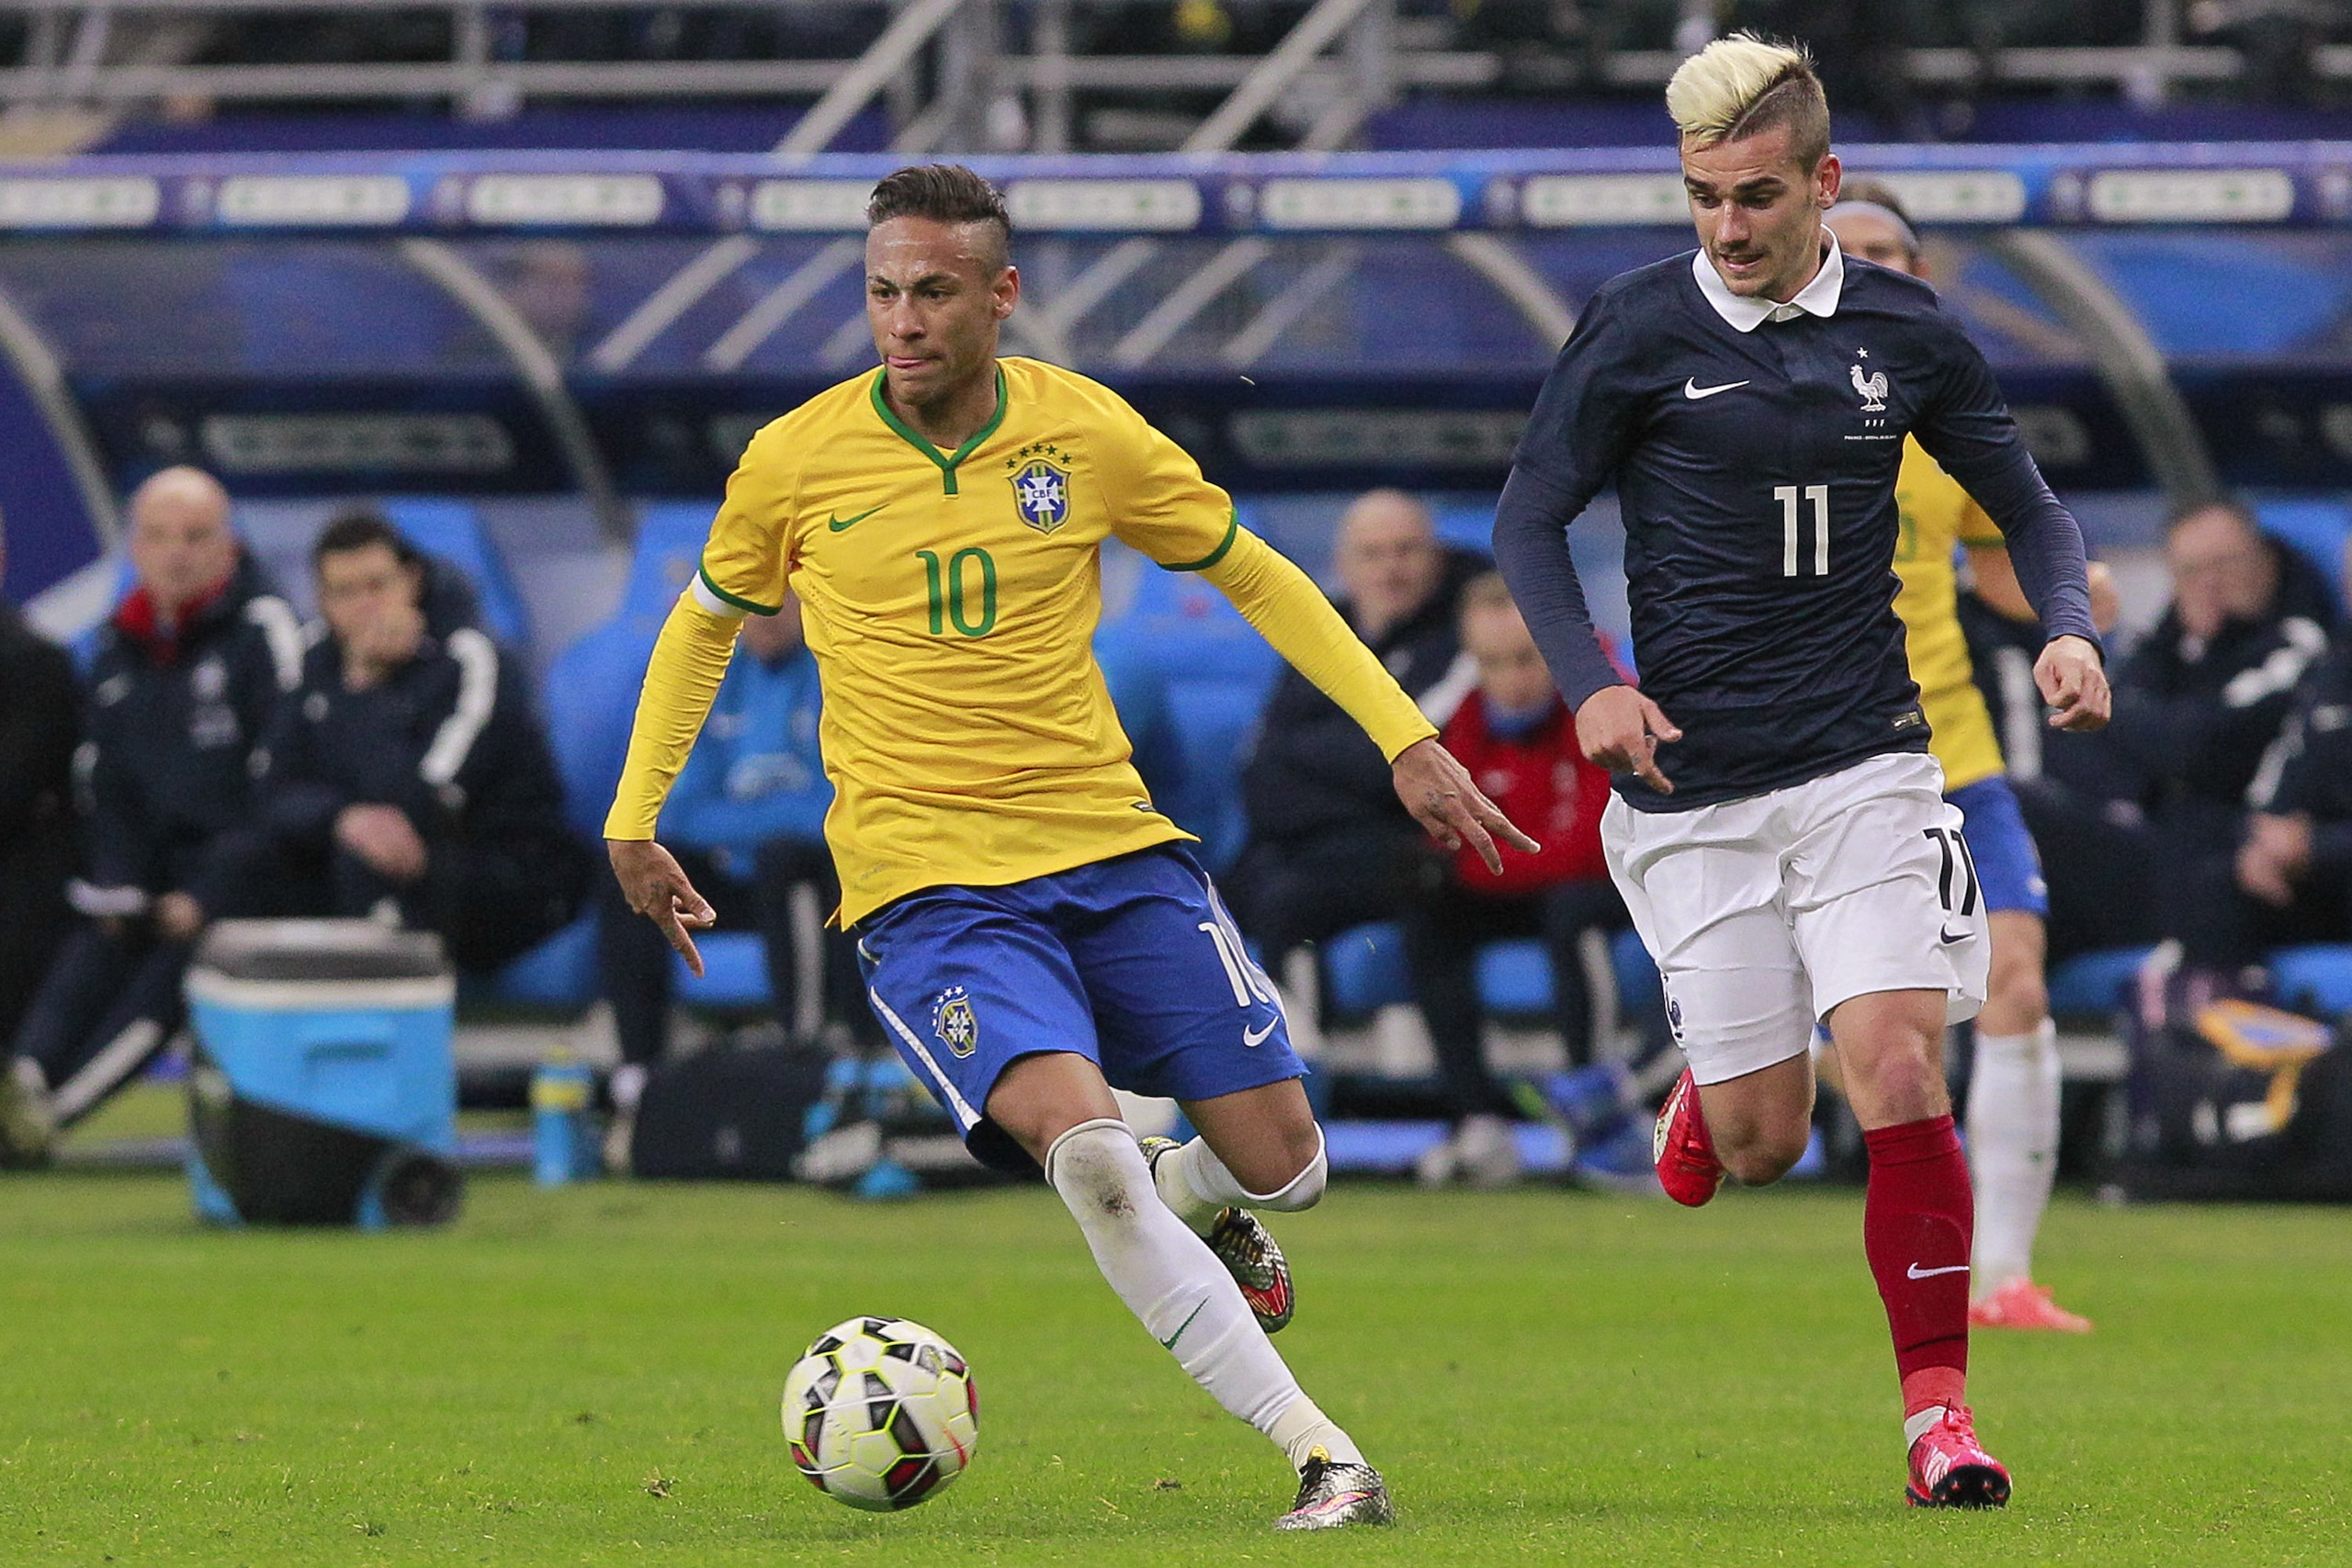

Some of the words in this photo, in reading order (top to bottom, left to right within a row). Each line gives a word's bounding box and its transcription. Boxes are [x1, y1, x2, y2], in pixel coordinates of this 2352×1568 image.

[1032, 489, 1052, 499] CBF
[1774, 485, 1828, 577] 11
[916, 547, 996, 637] 10
[1922, 828, 1977, 917] 11
